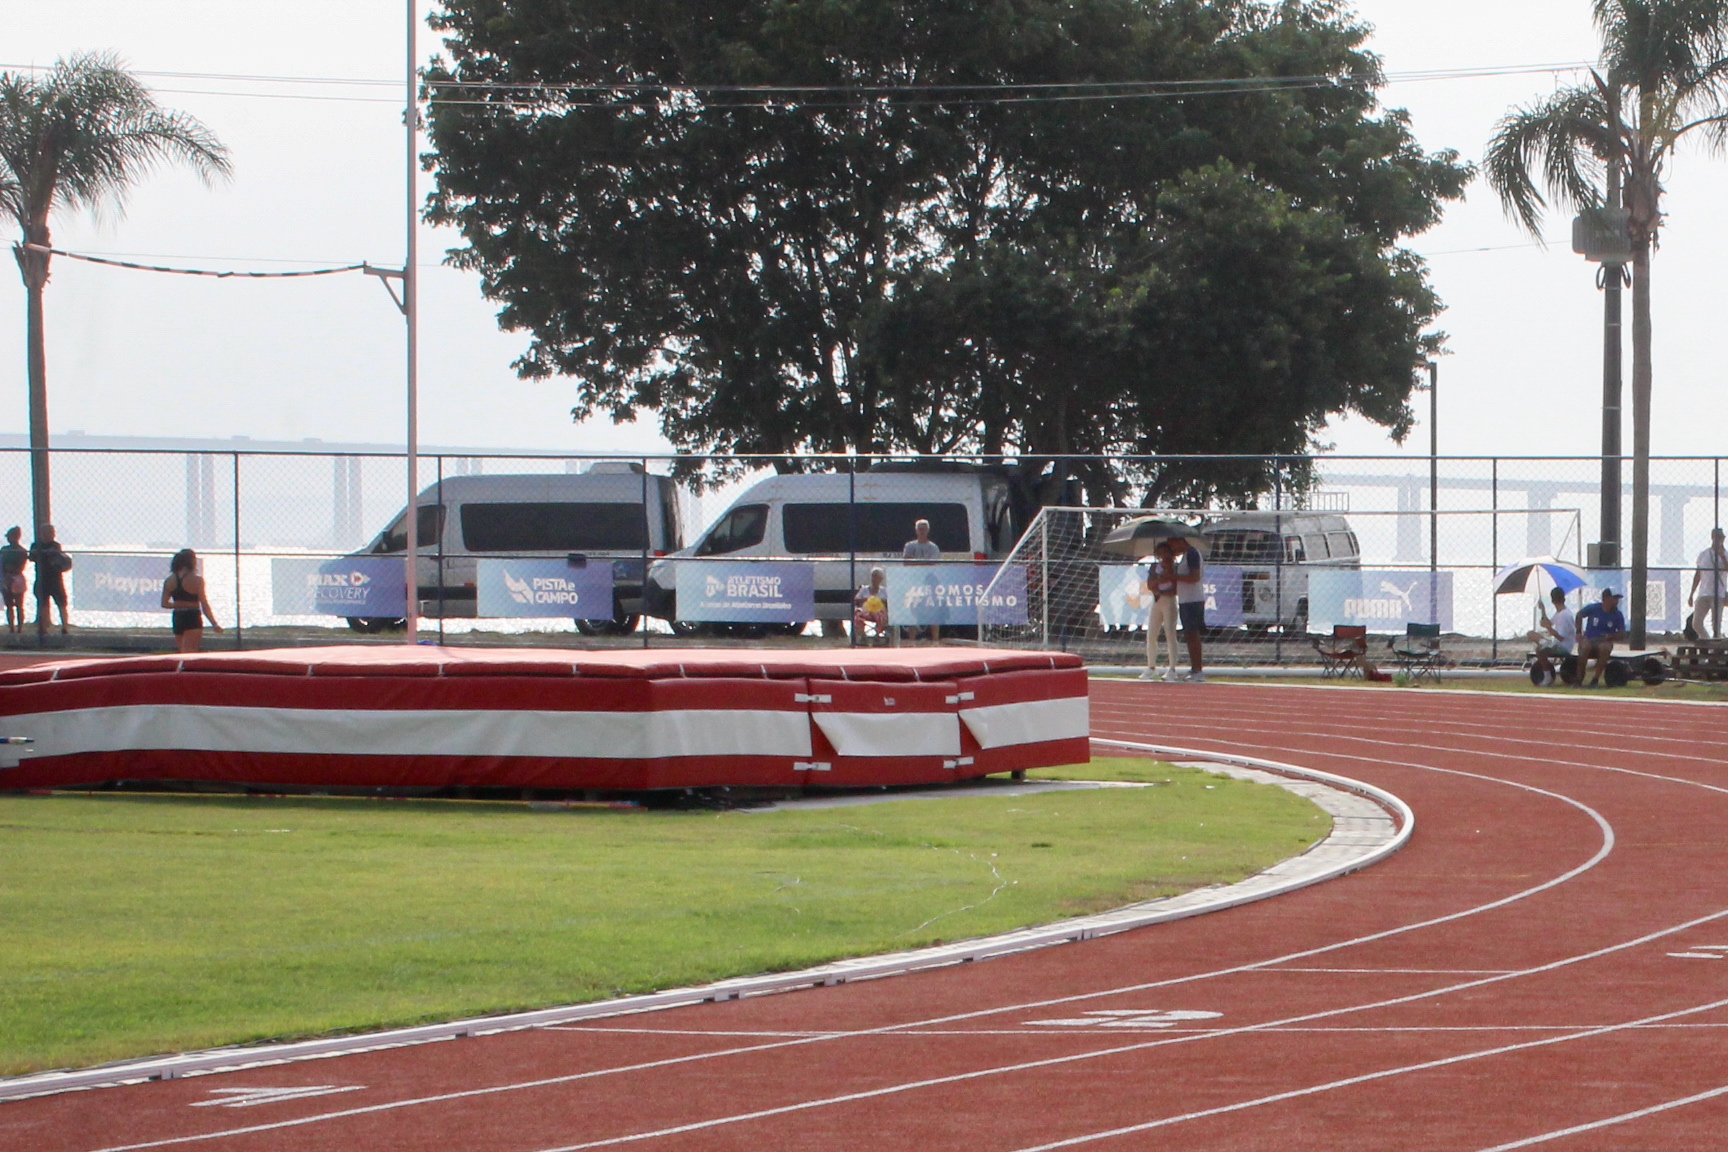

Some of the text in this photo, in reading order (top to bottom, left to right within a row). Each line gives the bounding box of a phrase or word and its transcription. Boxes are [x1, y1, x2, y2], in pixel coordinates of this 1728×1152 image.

[93, 572, 165, 596] Playpis
[306, 573, 348, 586] MAX
[533, 577, 567, 590] PISTA
[727, 576, 782, 586] ATLETISMO
[535, 592, 579, 604] CAMPO
[727, 585, 783, 598] BRASIL
[925, 595, 1018, 607] ATLETISMO
[1344, 598, 1402, 618] PUMA
